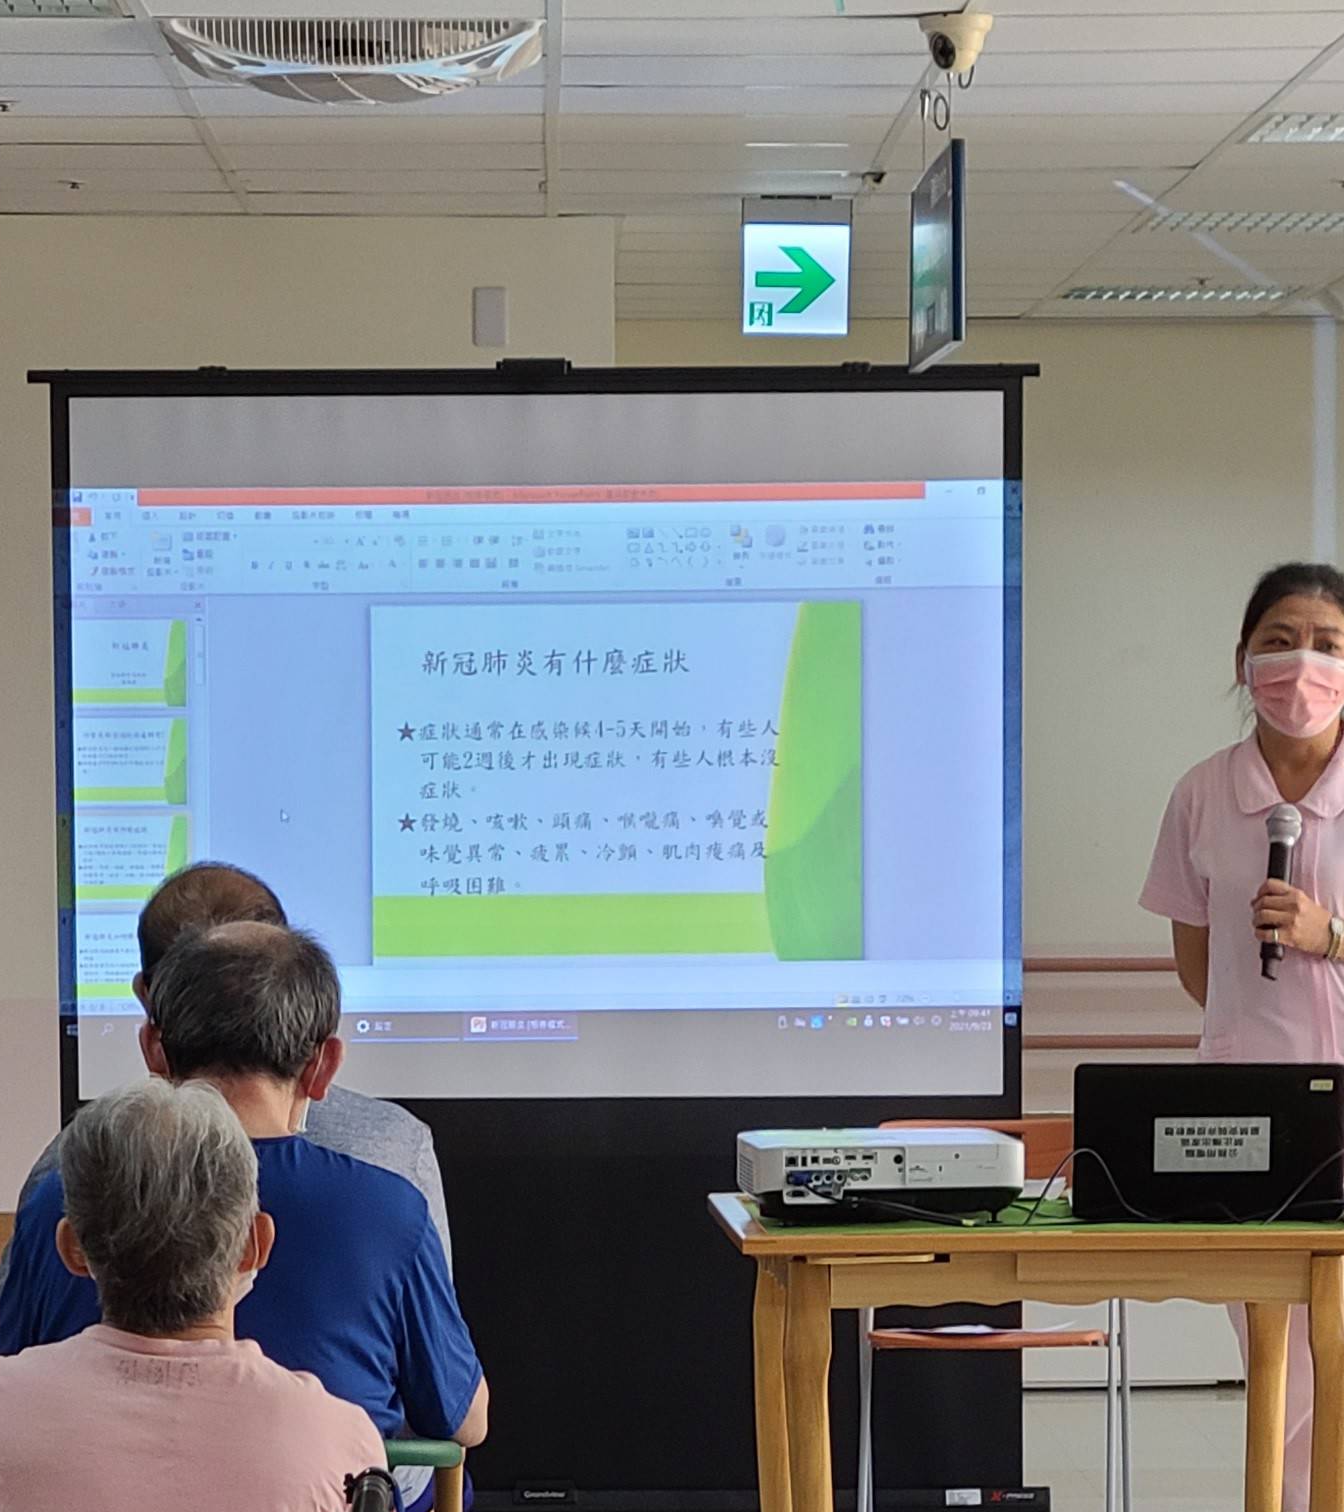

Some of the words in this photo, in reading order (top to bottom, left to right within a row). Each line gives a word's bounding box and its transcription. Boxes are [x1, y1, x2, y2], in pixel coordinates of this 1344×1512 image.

[421, 648, 690, 677] 新冠肺炎有什麼症狀
[419, 876, 522, 897] 呼吸困難。
